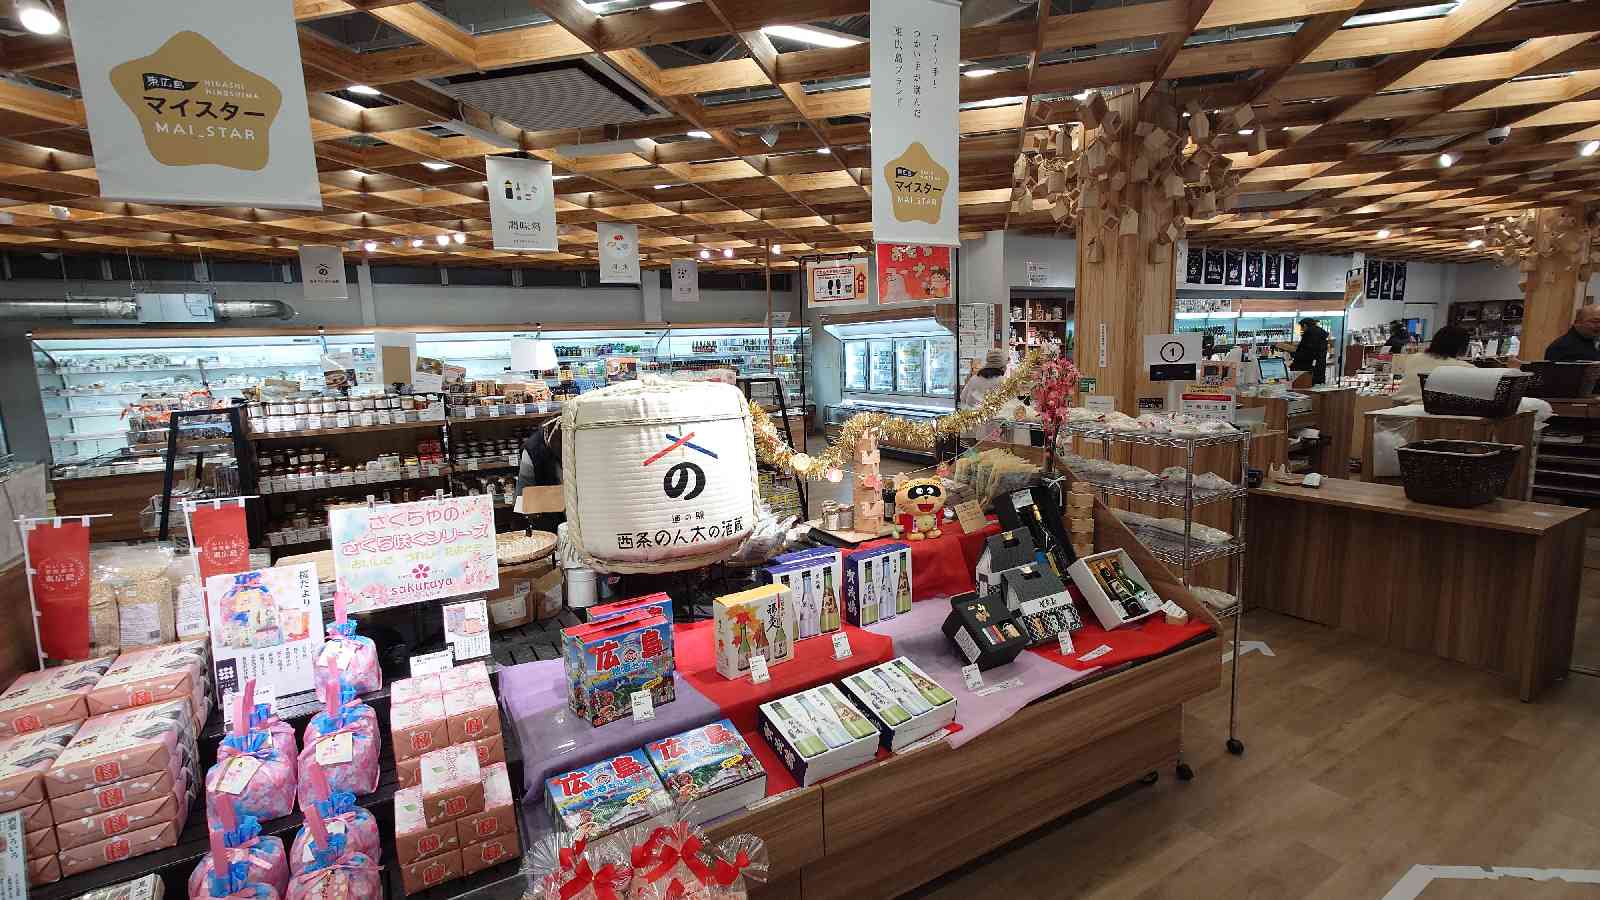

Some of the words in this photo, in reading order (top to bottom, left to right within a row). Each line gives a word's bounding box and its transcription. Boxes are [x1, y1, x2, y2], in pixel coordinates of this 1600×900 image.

[893, 25, 905, 106] 東広島ブランド
[147, 76, 185, 90] 東広島
[144, 96, 264, 121] マイスター
[894, 181, 942, 193] マイスター
[663, 461, 707, 501] の
[368, 506, 460, 531] さくらやの
[391, 576, 454, 597] sakuraya
[559, 755, 645, 798] 広島
